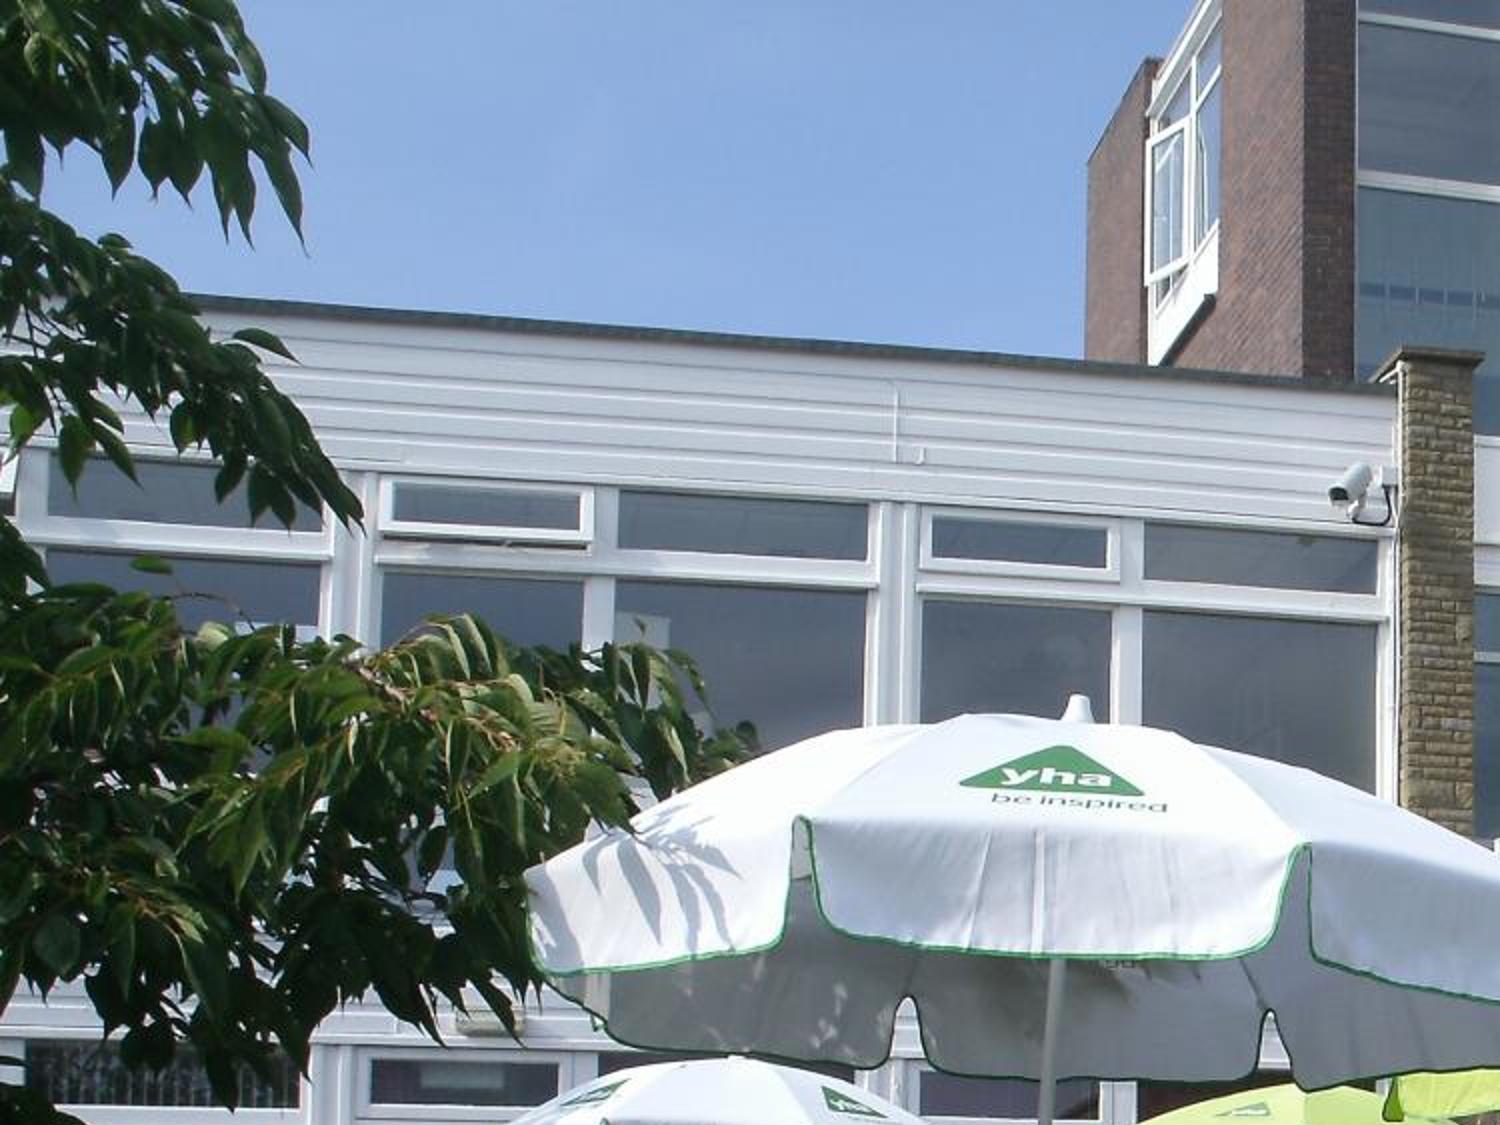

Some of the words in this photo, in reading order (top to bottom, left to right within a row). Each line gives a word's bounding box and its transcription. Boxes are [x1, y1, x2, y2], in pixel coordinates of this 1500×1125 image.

[1001, 768, 1112, 787] yha
[992, 793, 1032, 803] be
[1040, 795, 1168, 813] inspired
